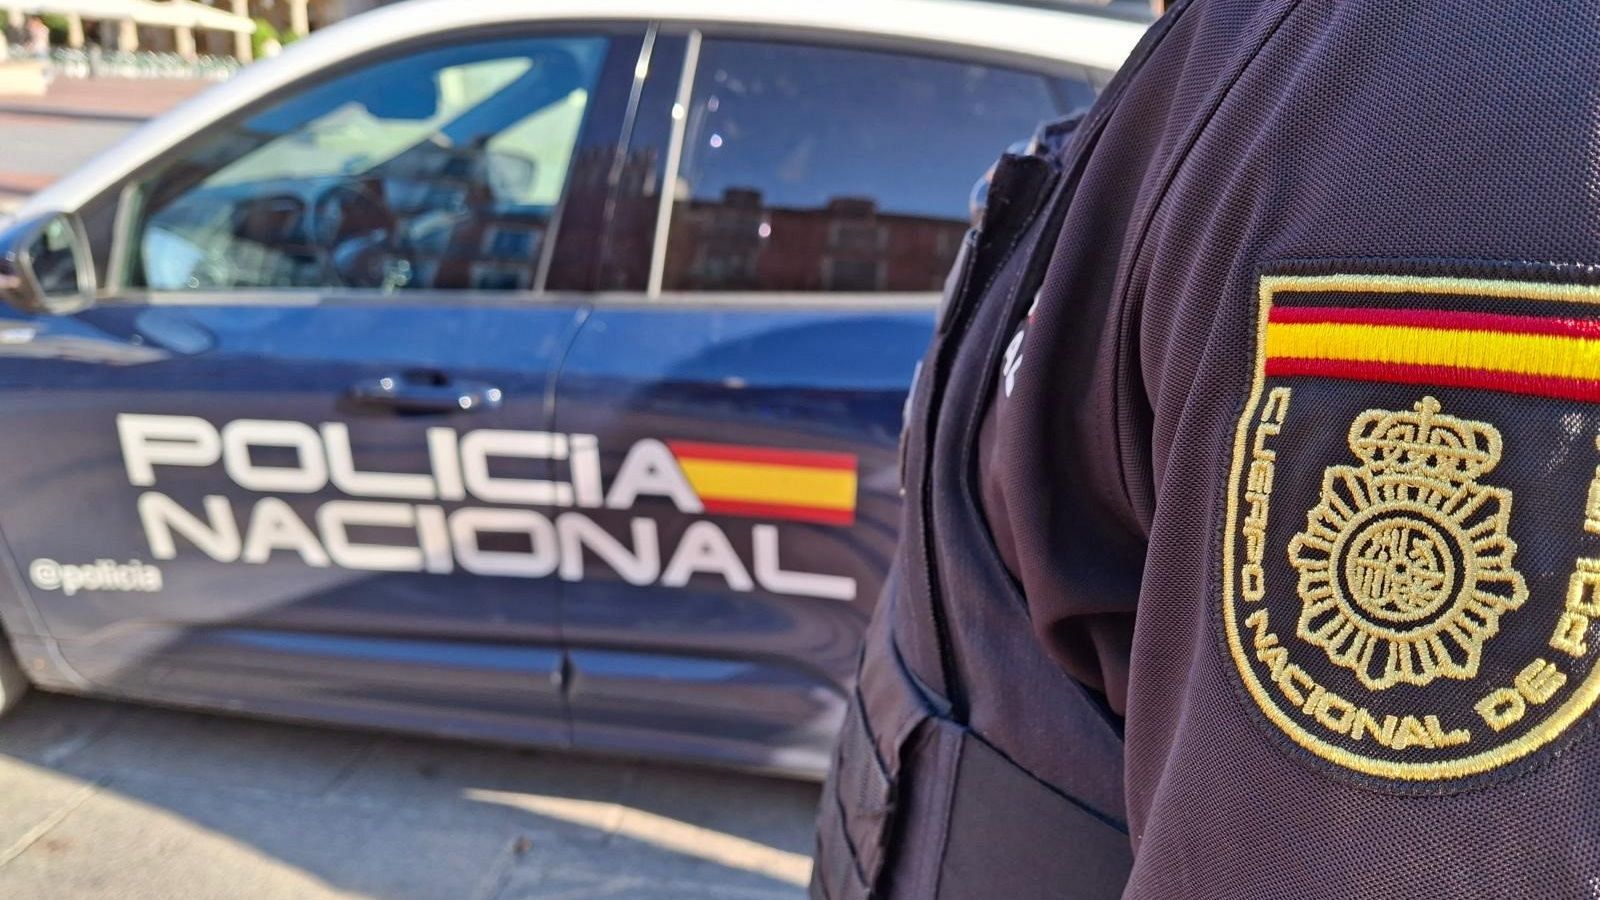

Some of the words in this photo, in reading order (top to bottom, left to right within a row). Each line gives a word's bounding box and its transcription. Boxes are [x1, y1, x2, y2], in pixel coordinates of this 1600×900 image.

[29, 558, 163, 596] @policia
[138, 491, 856, 600] NACIONAL
[1245, 607, 1472, 750] NACIONAL
[1475, 656, 1568, 733] DE
